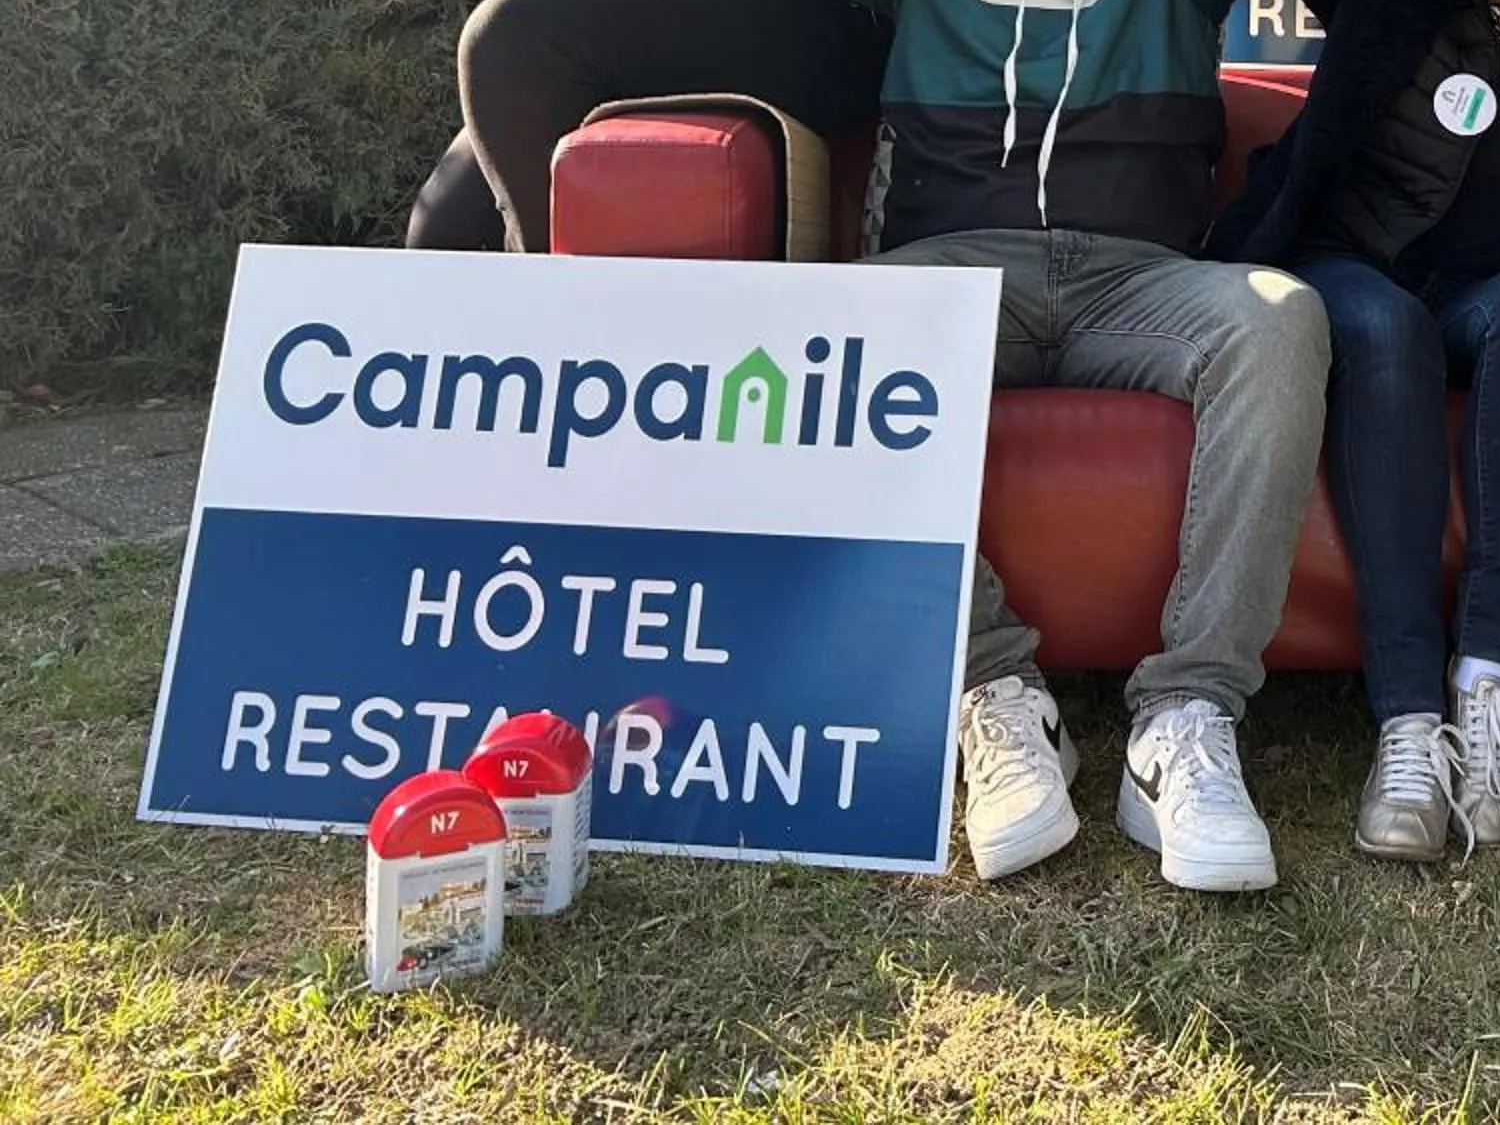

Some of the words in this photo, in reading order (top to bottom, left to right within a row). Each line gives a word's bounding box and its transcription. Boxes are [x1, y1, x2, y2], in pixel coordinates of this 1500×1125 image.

[263, 322, 940, 469] Campanile
[401, 545, 730, 665] HÔTEL
[503, 759, 529, 780] N7
[430, 810, 461, 835] N7
